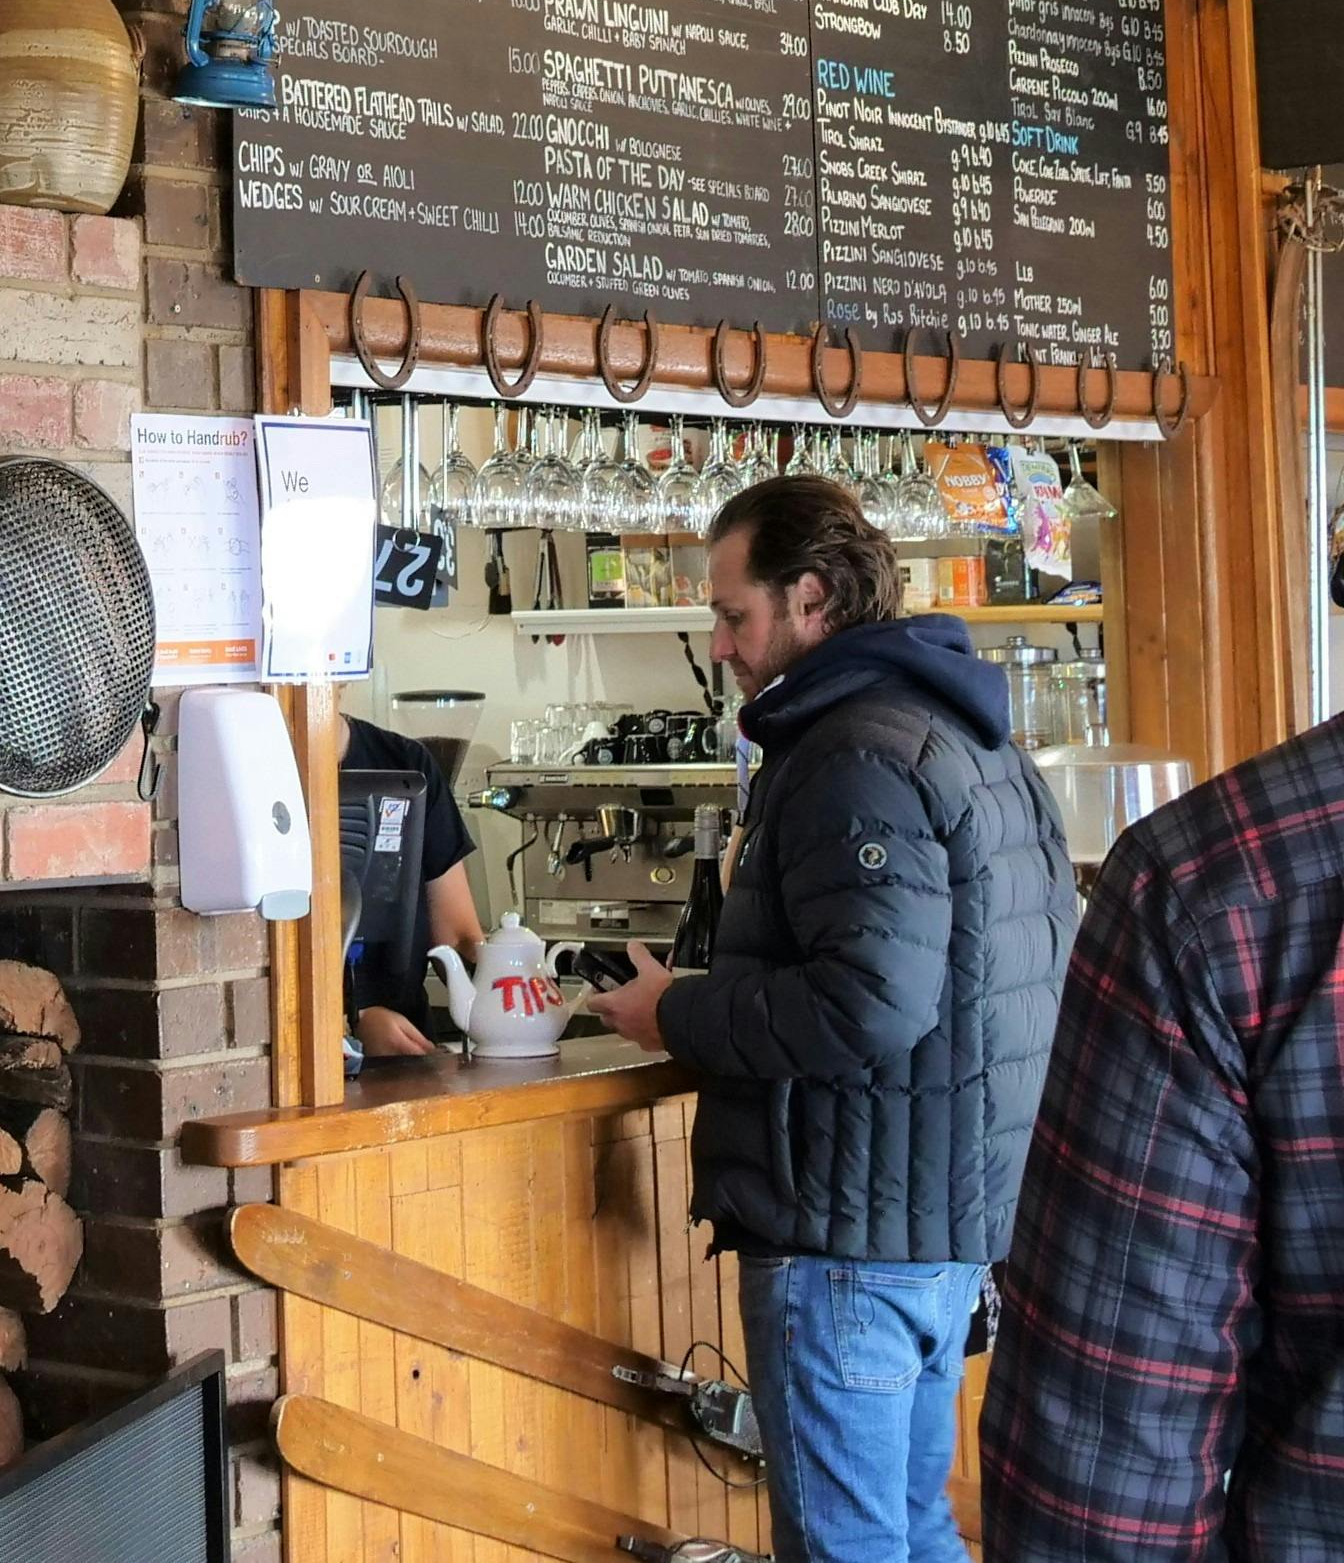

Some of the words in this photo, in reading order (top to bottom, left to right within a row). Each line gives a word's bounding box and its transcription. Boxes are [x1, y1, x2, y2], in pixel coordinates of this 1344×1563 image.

[603, 0, 669, 36] LINGUINI
[814, 3, 882, 40] STRONGBOW
[303, 16, 359, 46] TOASTED
[363, 27, 438, 59] SOURDOUGH
[508, 46, 541, 74] 15.00
[543, 49, 632, 92] SPAGHETTI
[638, 64, 734, 109] PUTTANESCA
[817, 58, 851, 90] RED
[853, 66, 896, 98] WINE
[281, 74, 352, 114] BATTERED
[354, 86, 415, 123] FLATHEAD
[417, 98, 454, 128] TAILS
[471, 111, 505, 136] SALAD,
[512, 112, 544, 141] 22.00
[295, 109, 364, 135] HOUSEMADE
[370, 119, 407, 140] SAUCE
[545, 114, 610, 151] GNOCCHI
[816, 118, 847, 149] TIROL
[848, 125, 885, 152] SHIRAZ
[1012, 120, 1044, 148] SOFT
[1046, 125, 1079, 155] DRINK
[238, 141, 285, 177] CHIPS
[309, 154, 351, 182] GRAVY
[357, 163, 375, 181] OR
[383, 164, 415, 190] AIOLI
[544, 145, 593, 179] PASTA
[596, 156, 616, 181] OF
[617, 158, 652, 188] THE
[657, 164, 685, 192] DAY
[238, 179, 303, 210] WEDGES
[330, 191, 362, 216] SOUR
[364, 195, 407, 223] CREAM
[417, 201, 459, 228] SWEET
[463, 207, 500, 235] CHILLI
[546, 181, 592, 211] WARM
[594, 188, 656, 221] CHICKEN
[662, 195, 709, 227] SALAD
[545, 242, 607, 275] GARDEN
[612, 251, 663, 281] SALAD
[137, 428, 167, 444] How
[170, 430, 183, 445] to
[187, 429, 248, 446] Handrub?
[281, 469, 309, 493] We
[945, 474, 987, 488] NOBBY
[374, 539, 431, 596] 27
[491, 976, 563, 1017] TIPS
